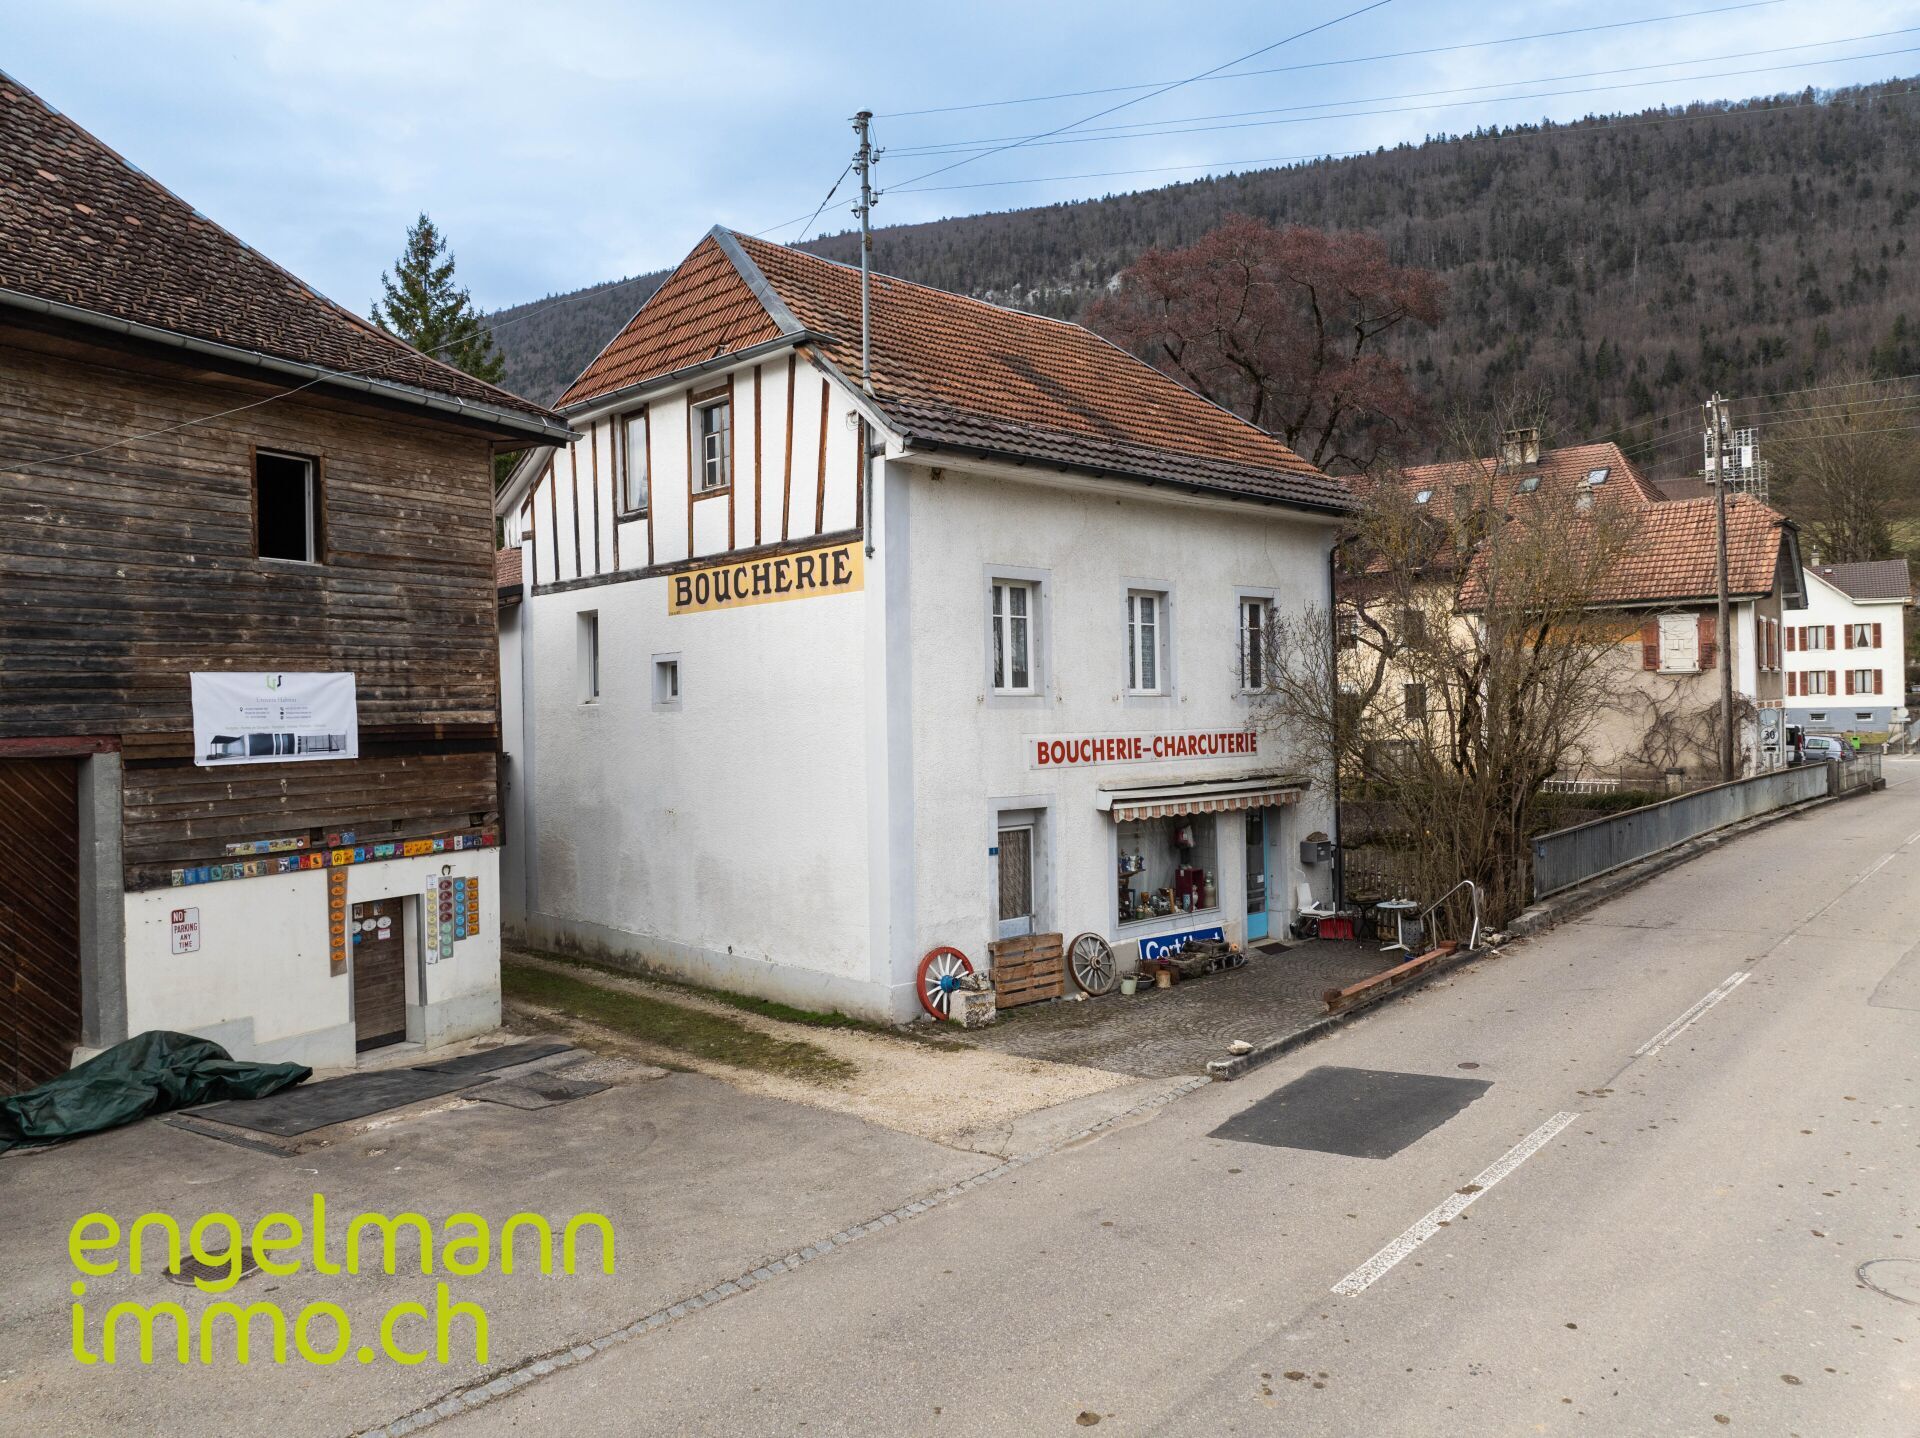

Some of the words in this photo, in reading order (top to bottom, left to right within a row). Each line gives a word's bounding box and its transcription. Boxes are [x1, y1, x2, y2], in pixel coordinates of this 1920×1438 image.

[675, 547, 853, 607] BOUCHERIE
[1764, 730, 1776, 740] 30
[1037, 732, 1257, 765] BOUCHERIE-CHARCUTERIE
[173, 911, 184, 922] NO
[174, 923, 198, 934] PARKING
[179, 941, 193, 949] TIME
